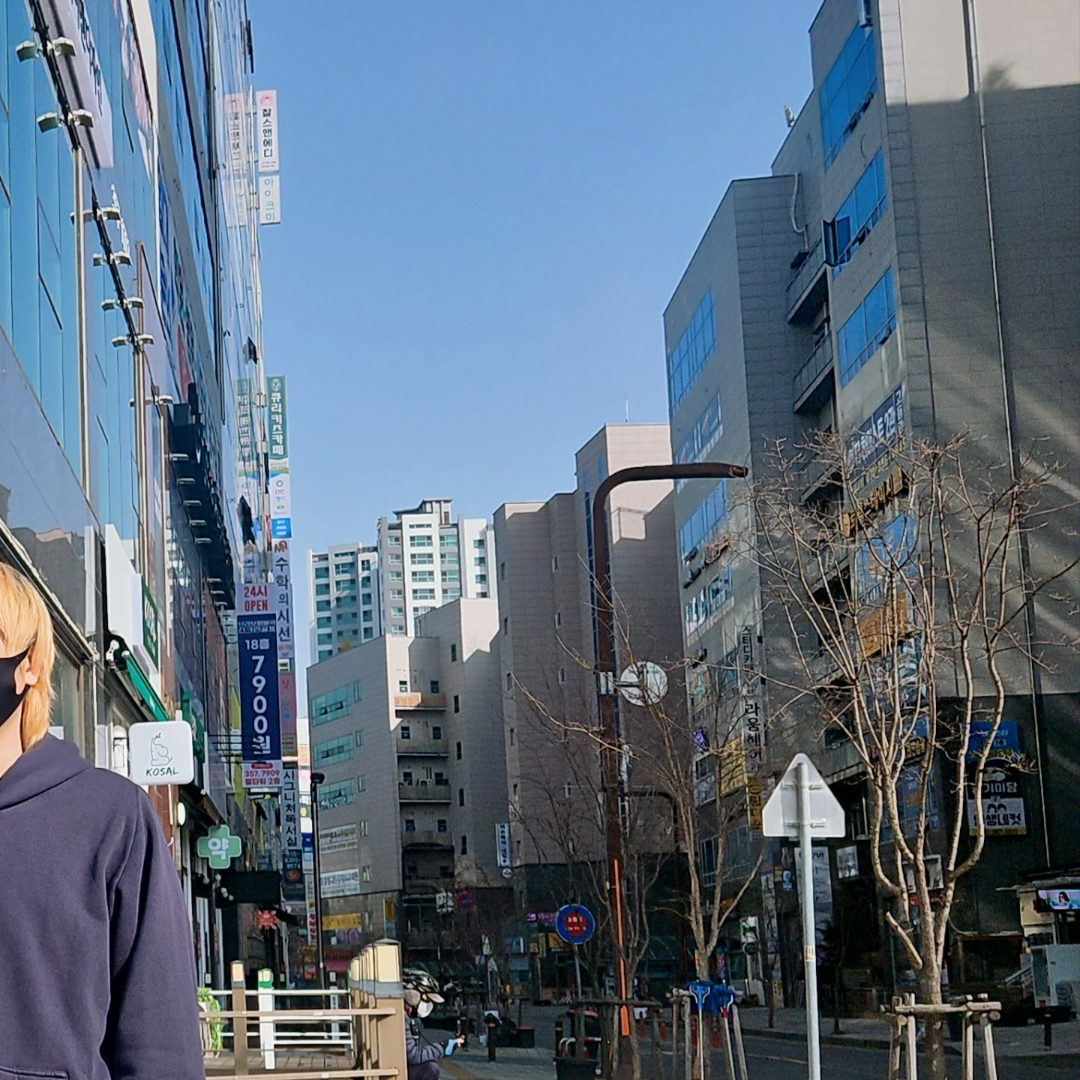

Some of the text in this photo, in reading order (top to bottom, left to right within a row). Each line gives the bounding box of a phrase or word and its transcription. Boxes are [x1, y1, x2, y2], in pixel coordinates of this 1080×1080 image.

[244, 585, 268, 598] 24시
[244, 600, 268, 612] OPEN
[275, 557, 291, 642] 수학의시선
[245, 638, 270, 650] 18홀
[146, 767, 179, 777] KOSAL
[283, 770, 298, 847] 시그니처독서실
[207, 837, 229, 860] 약
